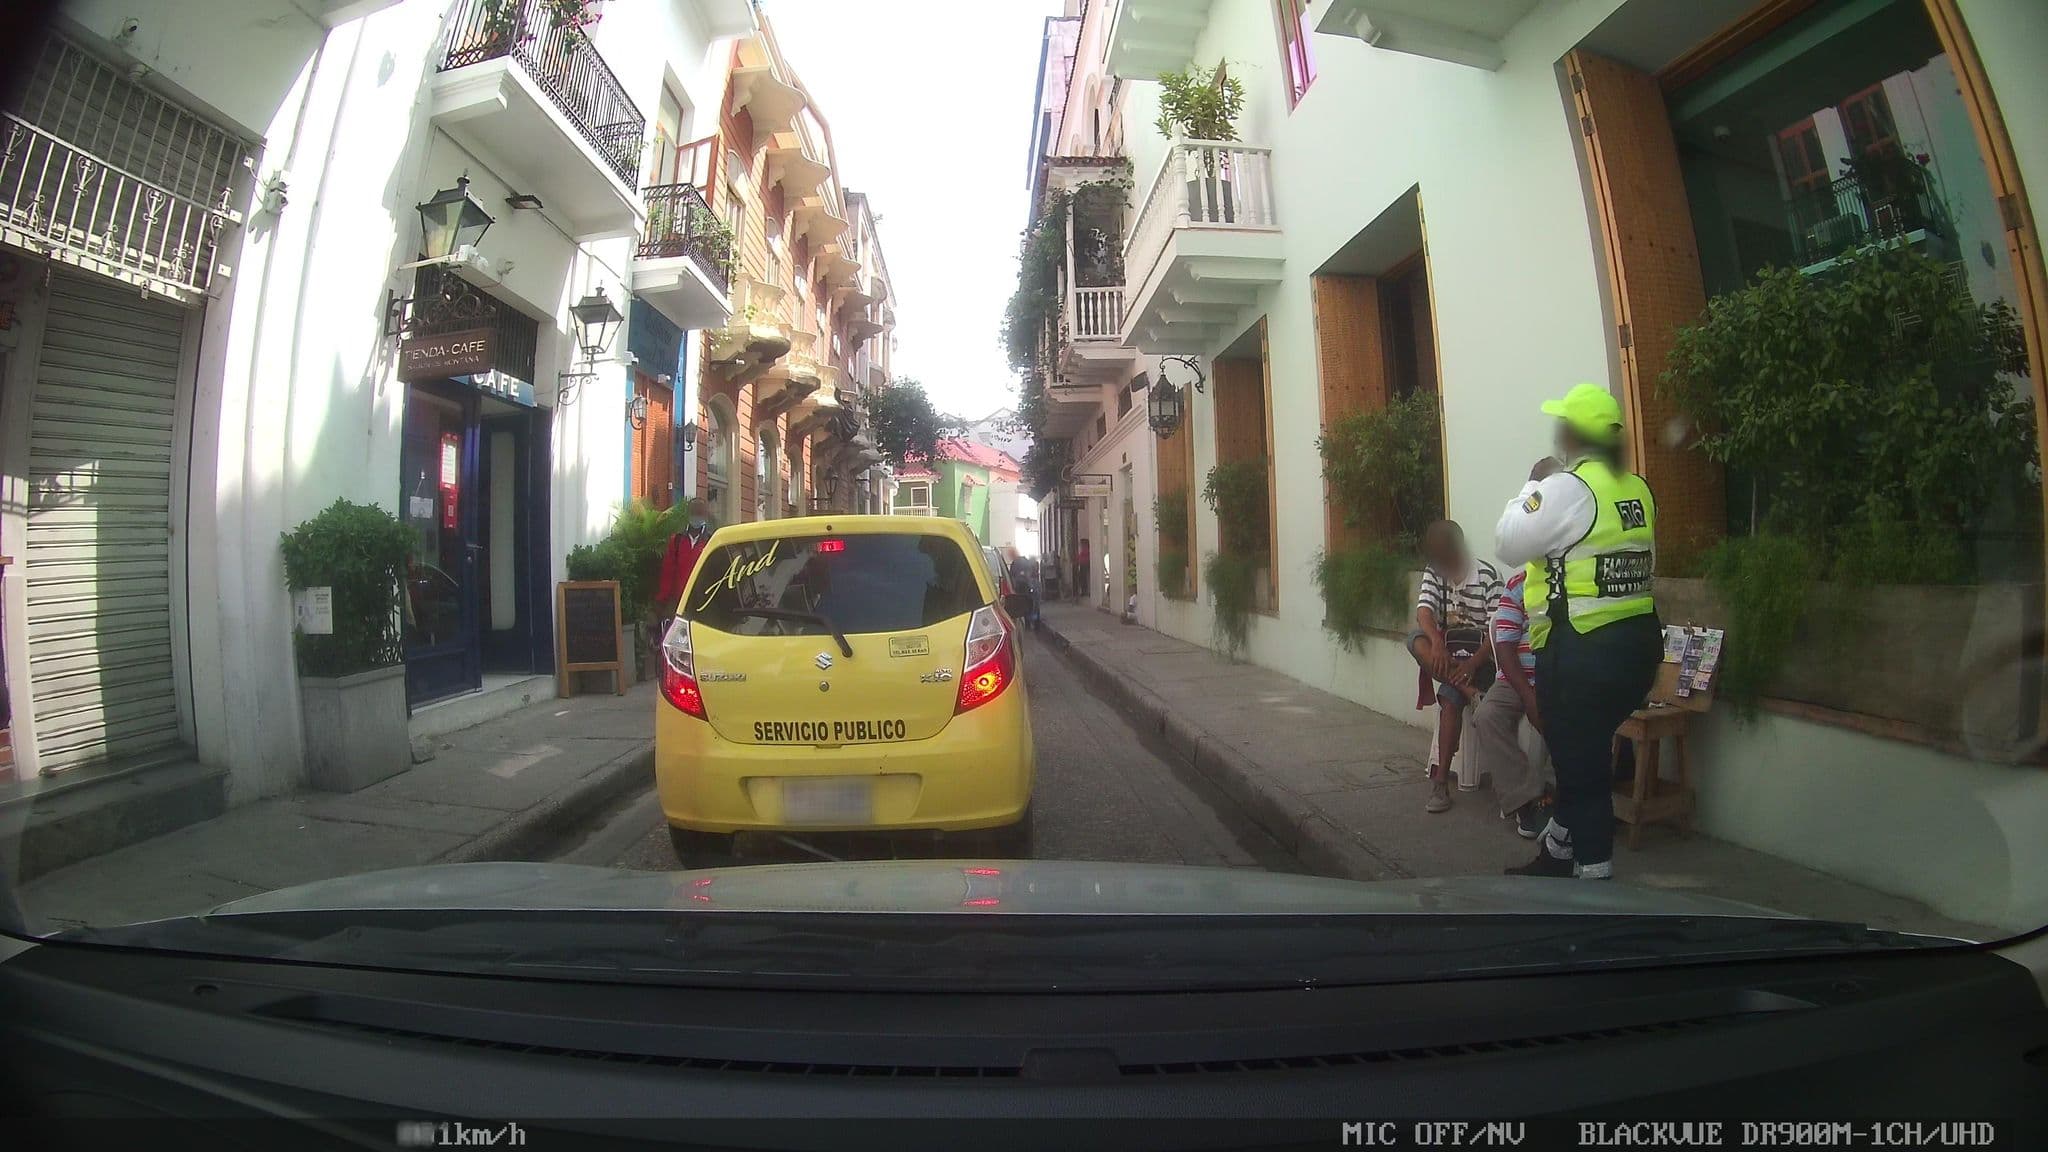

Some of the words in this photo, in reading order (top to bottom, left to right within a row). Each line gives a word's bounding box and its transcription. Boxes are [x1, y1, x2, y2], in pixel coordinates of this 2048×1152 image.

[696, 539, 780, 612] And
[753, 721, 829, 741] SERVICIO
[833, 719, 906, 741] PUBLICO
